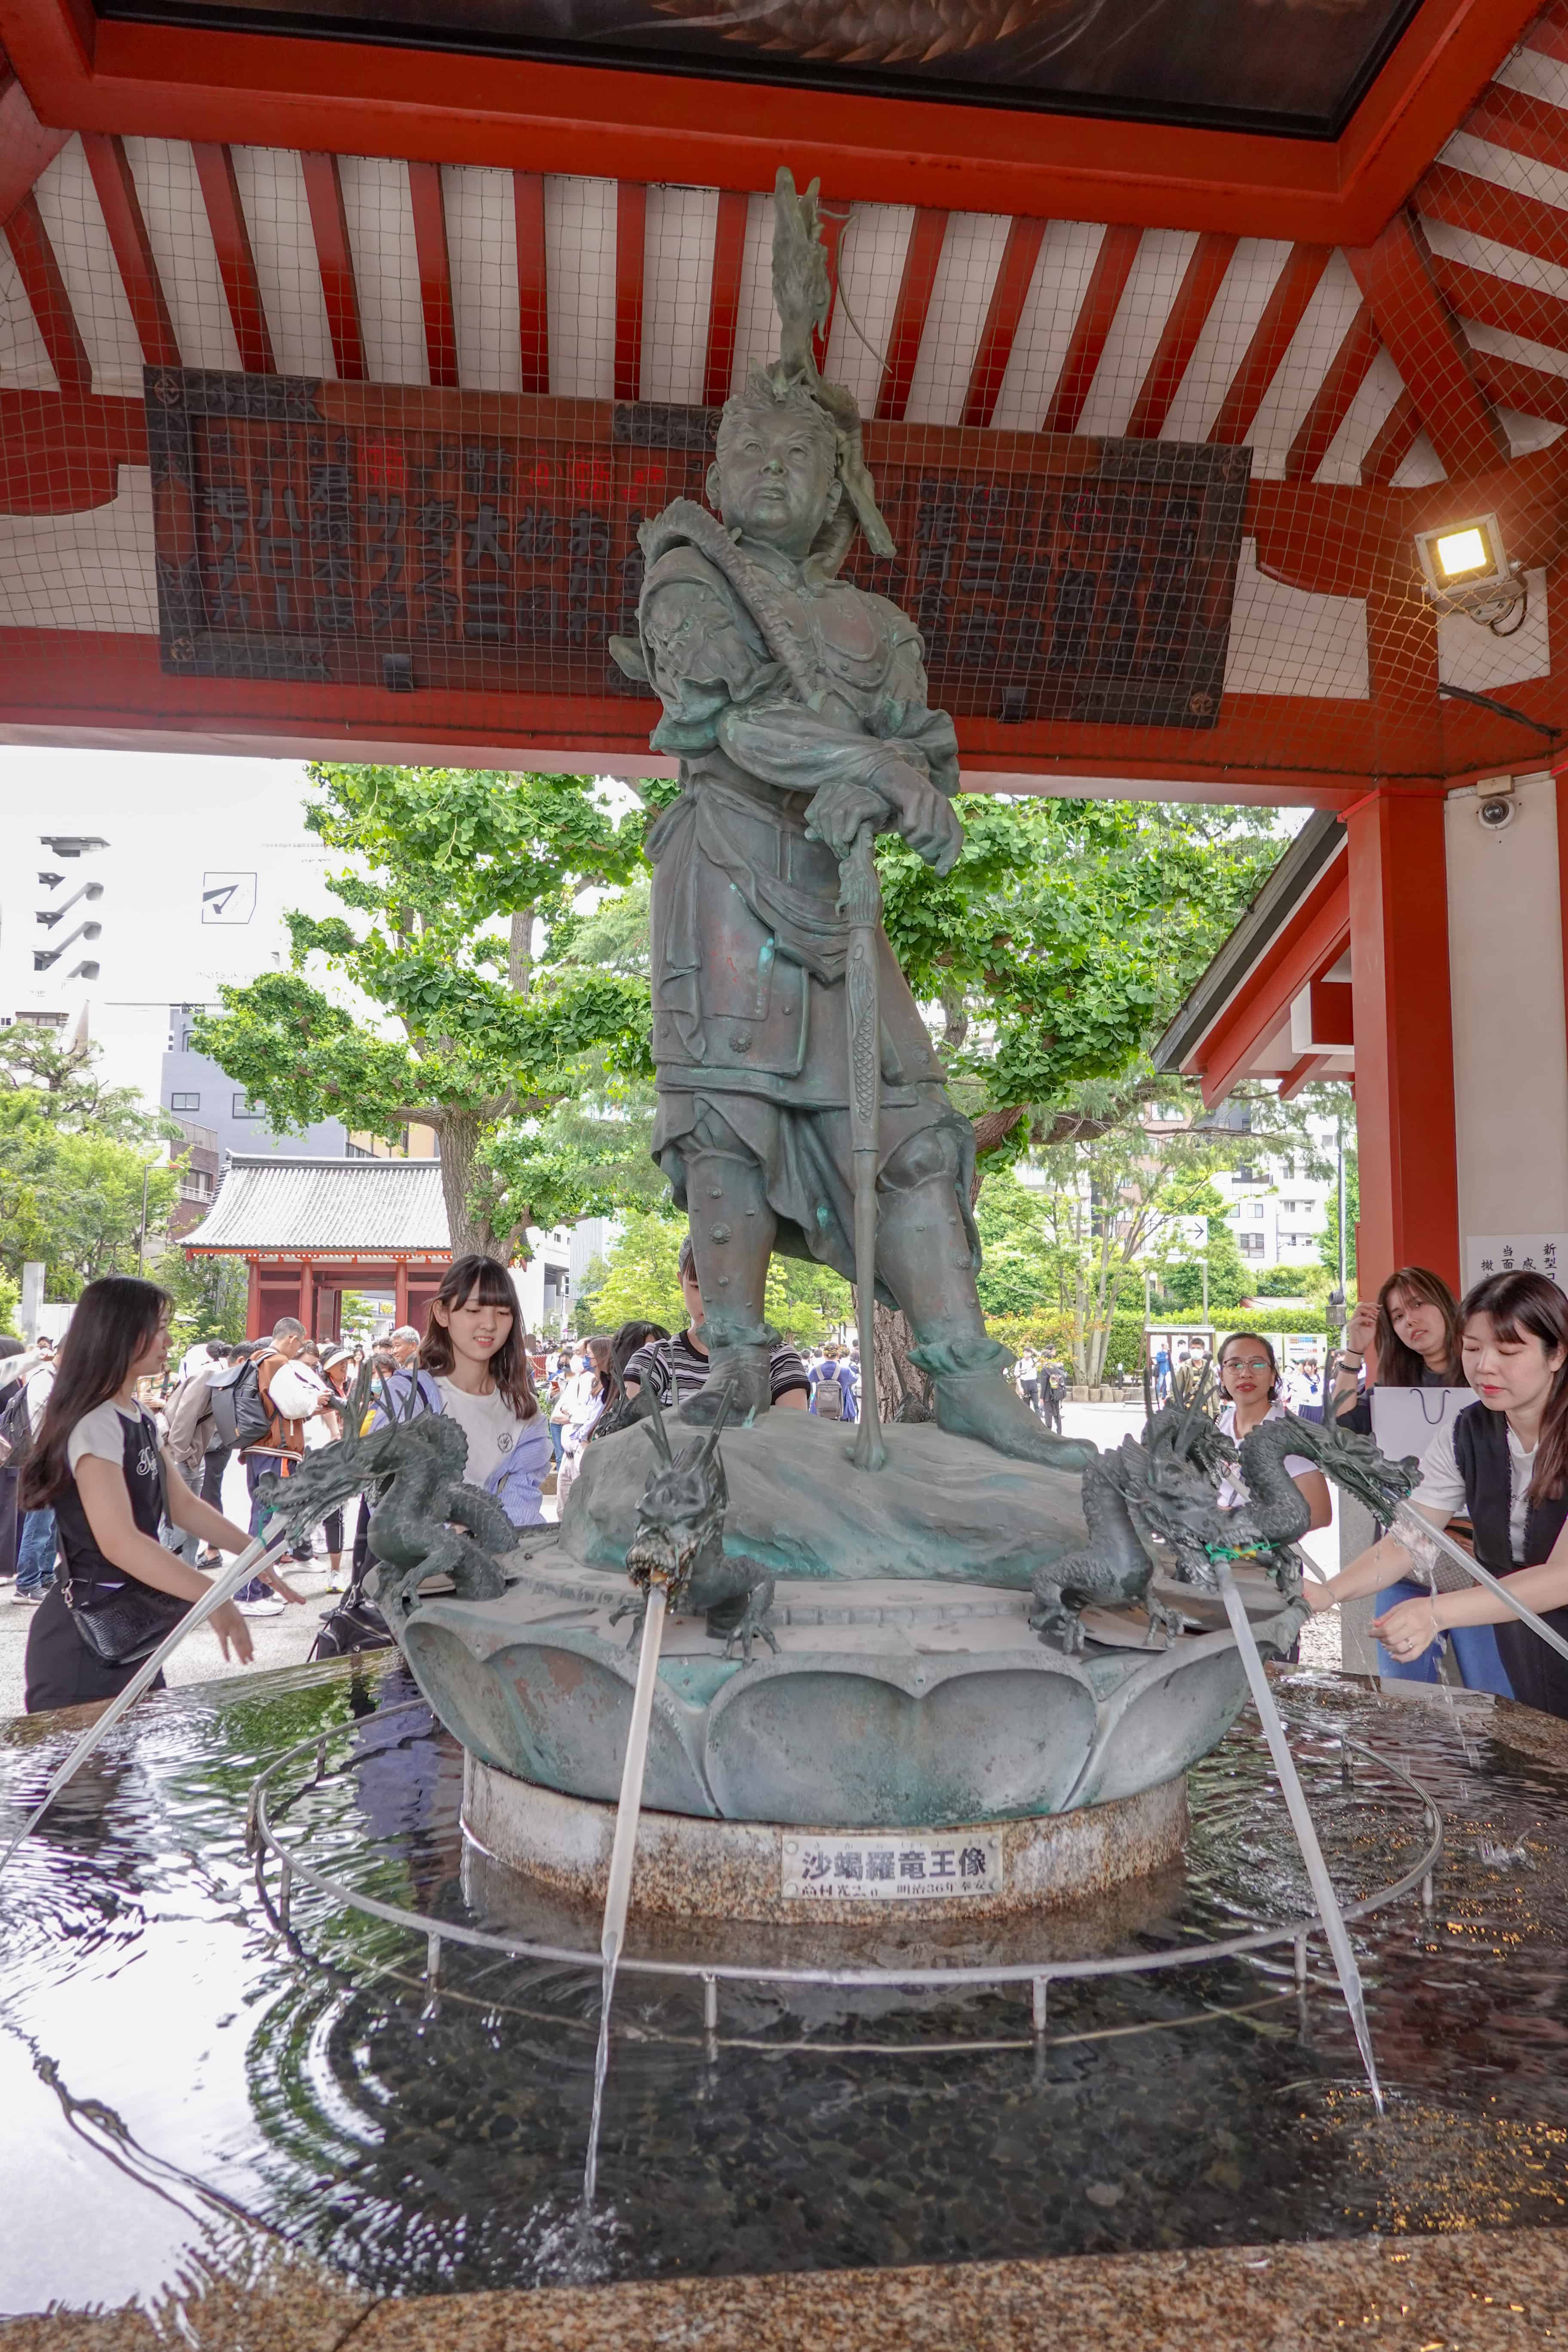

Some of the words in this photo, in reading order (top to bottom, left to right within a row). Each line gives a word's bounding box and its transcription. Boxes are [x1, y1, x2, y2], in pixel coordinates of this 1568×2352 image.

[203, 486, 253, 625] モリナカ
[256, 487, 304, 627] ハロー
[465, 505, 510, 640] 大三
[1501, 1245, 1515, 1270] 当面
